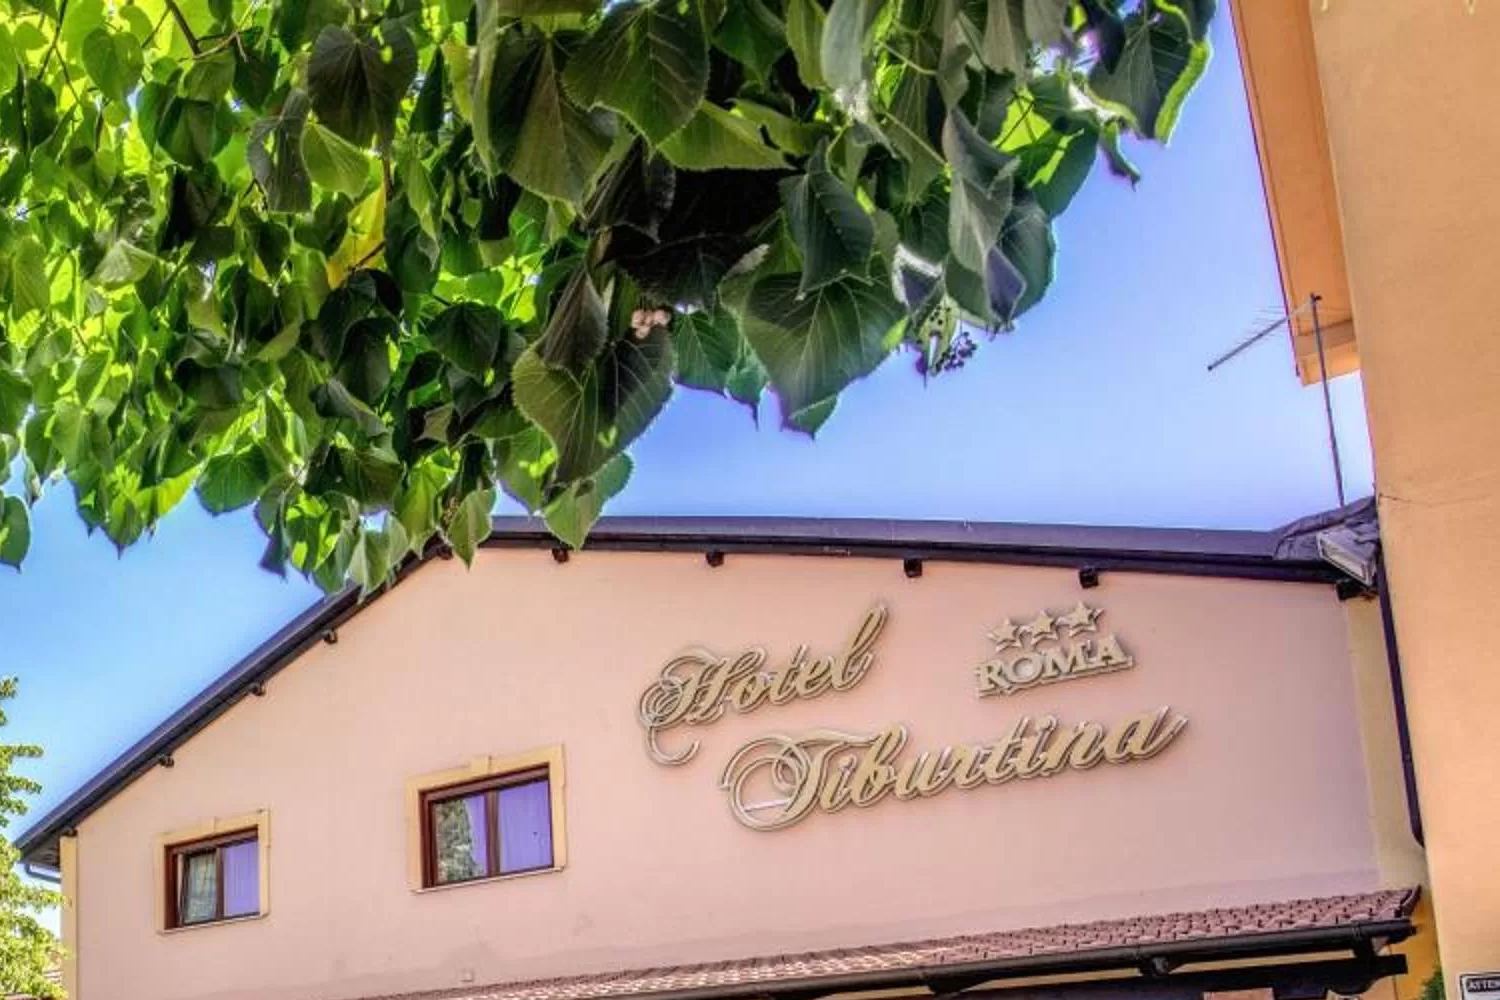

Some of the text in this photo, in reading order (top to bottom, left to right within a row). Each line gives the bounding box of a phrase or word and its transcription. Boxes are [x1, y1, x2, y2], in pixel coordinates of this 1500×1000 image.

[639, 604, 888, 766] Hotel
[975, 634, 1134, 698] ROMA
[721, 704, 1188, 832] Tiburtina
